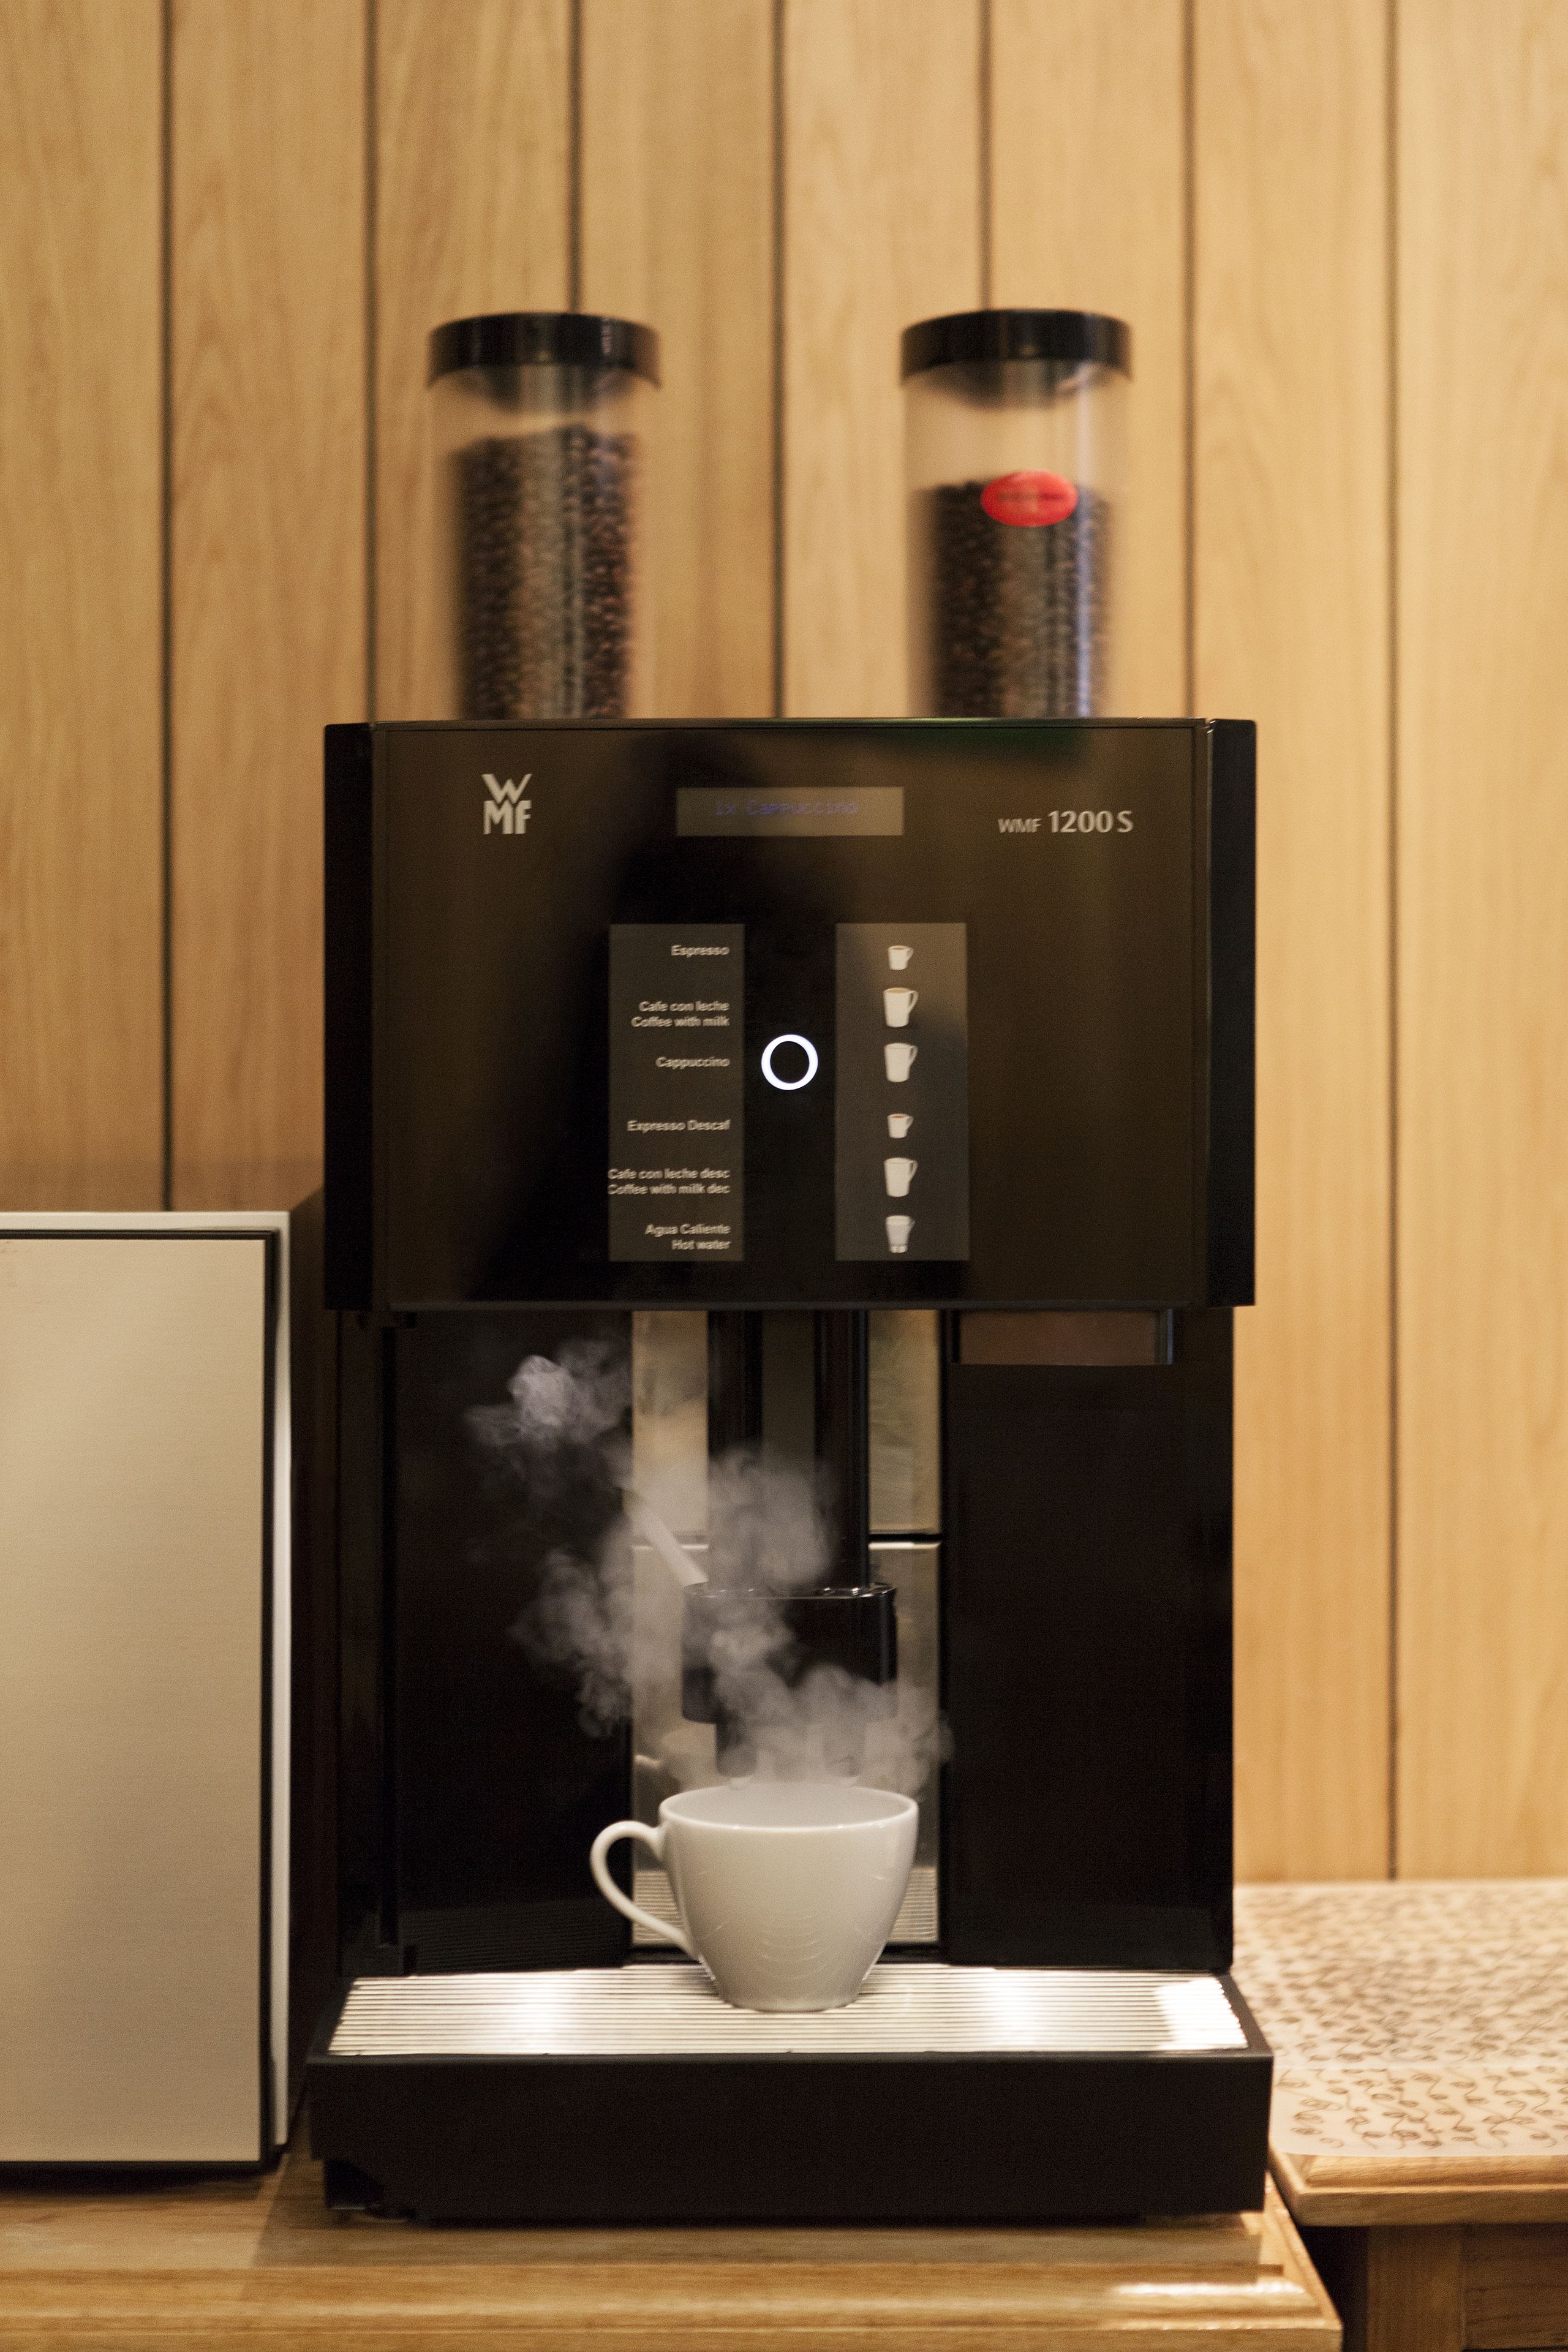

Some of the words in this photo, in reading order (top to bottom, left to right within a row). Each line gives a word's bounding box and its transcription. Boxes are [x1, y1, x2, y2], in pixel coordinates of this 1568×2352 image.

[998, 818, 1041, 833] WMF
[671, 945, 730, 958] Espresso
[695, 1001, 730, 1011] leche
[631, 1016, 673, 1027] Coffee
[674, 1016, 701, 1027] with
[702, 1016, 730, 1027] milk
[655, 1057, 731, 1069] Cappuccino
[627, 1120, 686, 1133] Espresso
[687, 1120, 731, 1131] Descaf
[664, 1168, 699, 1178] leche
[699, 1168, 731, 1178] desc
[608, 1184, 649, 1194] Coffee
[650, 1184, 677, 1194] with
[677, 1183, 705, 1194] milk
[706, 1183, 731, 1194] dec
[645, 1224, 678, 1237] Agua
[679, 1224, 731, 1235] Caliente
[671, 1240, 695, 1250] Hot
[696, 1240, 731, 1250] water
